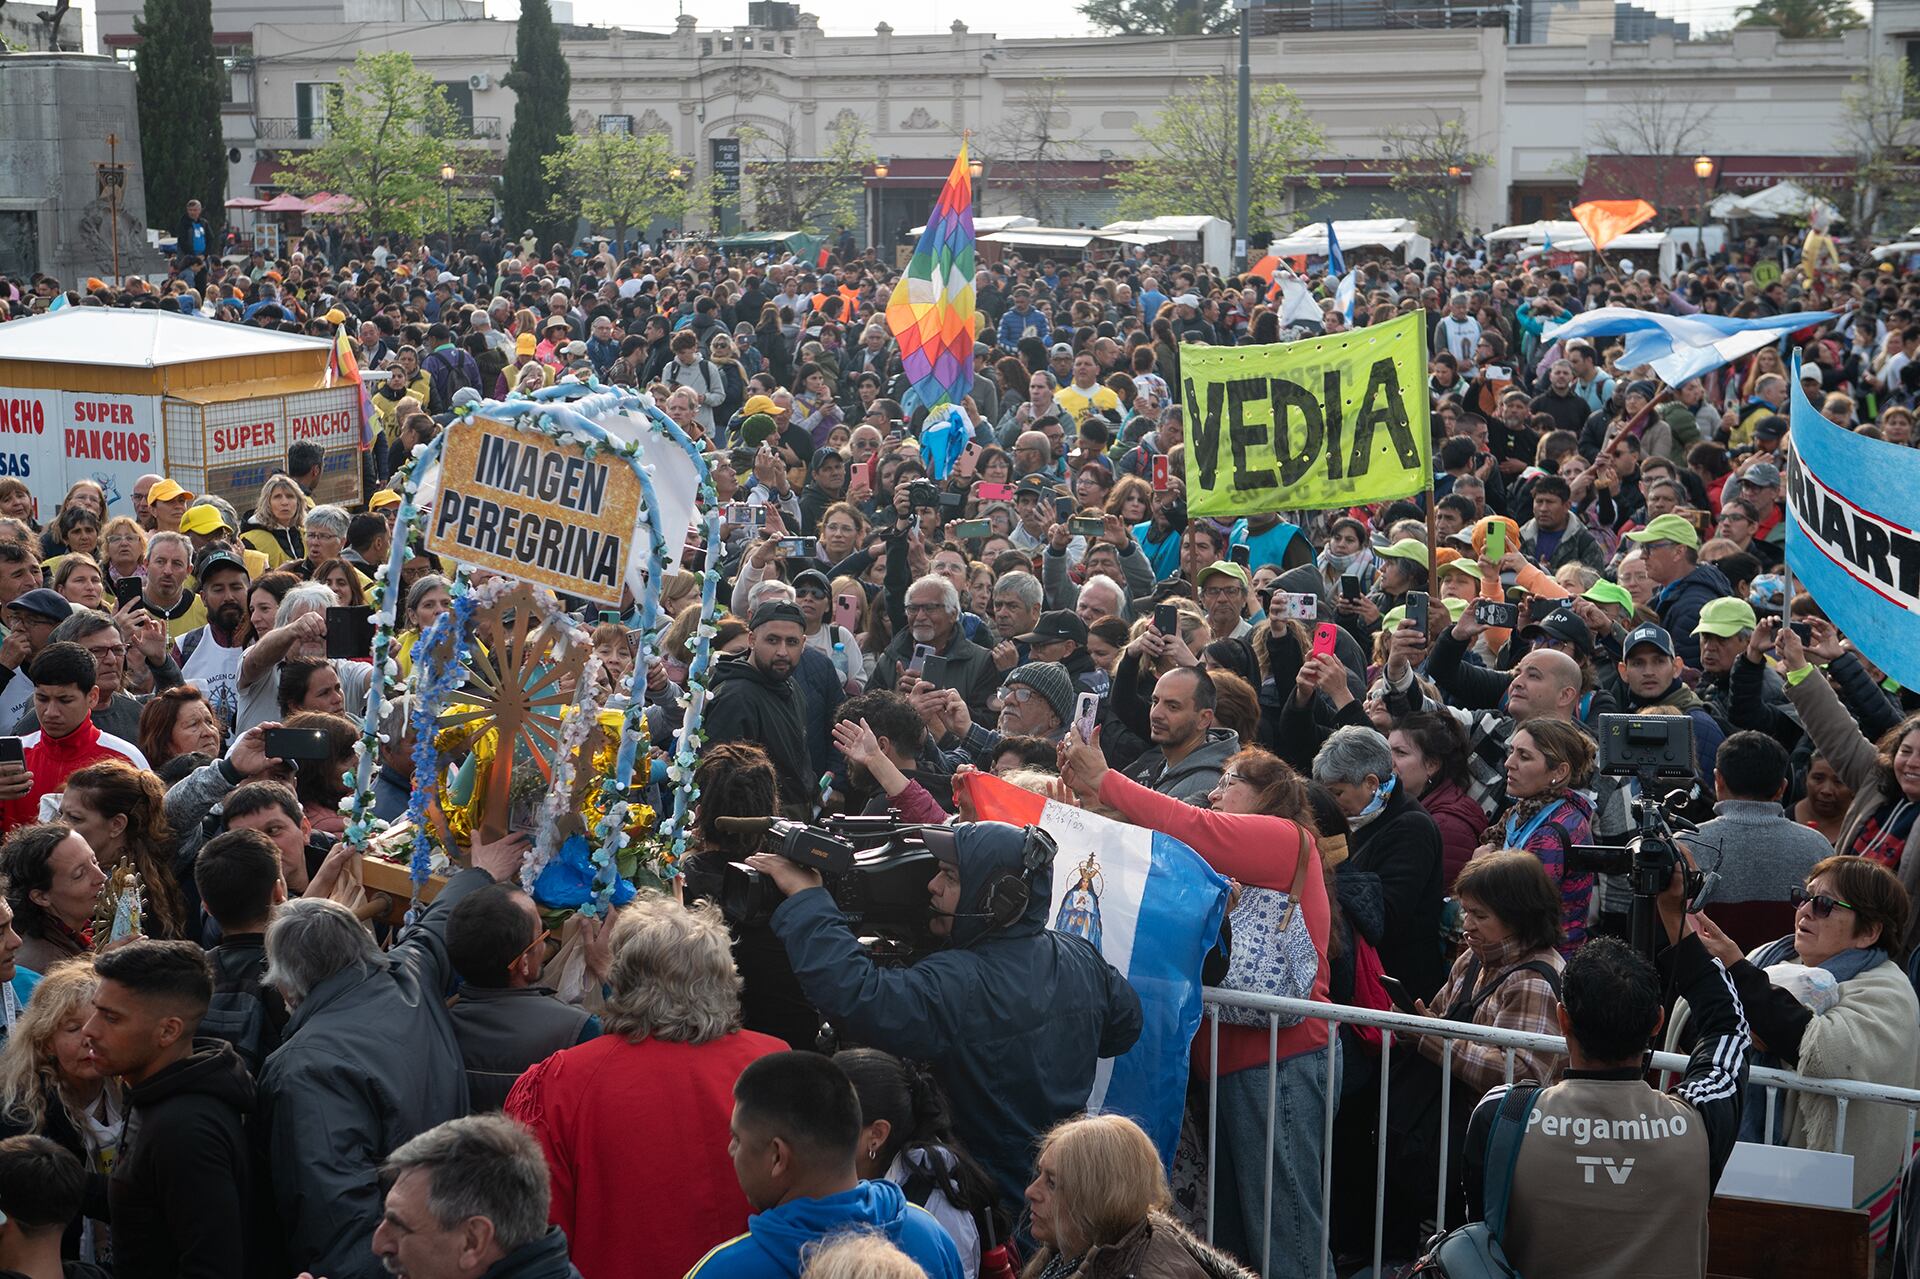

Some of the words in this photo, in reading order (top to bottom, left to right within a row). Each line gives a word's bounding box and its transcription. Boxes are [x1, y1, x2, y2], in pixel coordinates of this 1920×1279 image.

[1735, 175, 1771, 188] CAFÉ
[74, 401, 134, 425] SUPER
[213, 422, 276, 453] SUPER
[292, 410, 351, 440] PANCHO
[1184, 357, 1421, 491] VEDIA
[64, 429, 150, 464] PANCHOS
[474, 433, 609, 516] IMAGEN
[436, 489, 620, 588] PEREGRINA
[1526, 1108, 1687, 1145] Pergamino
[1576, 1155, 1635, 1184] TV
